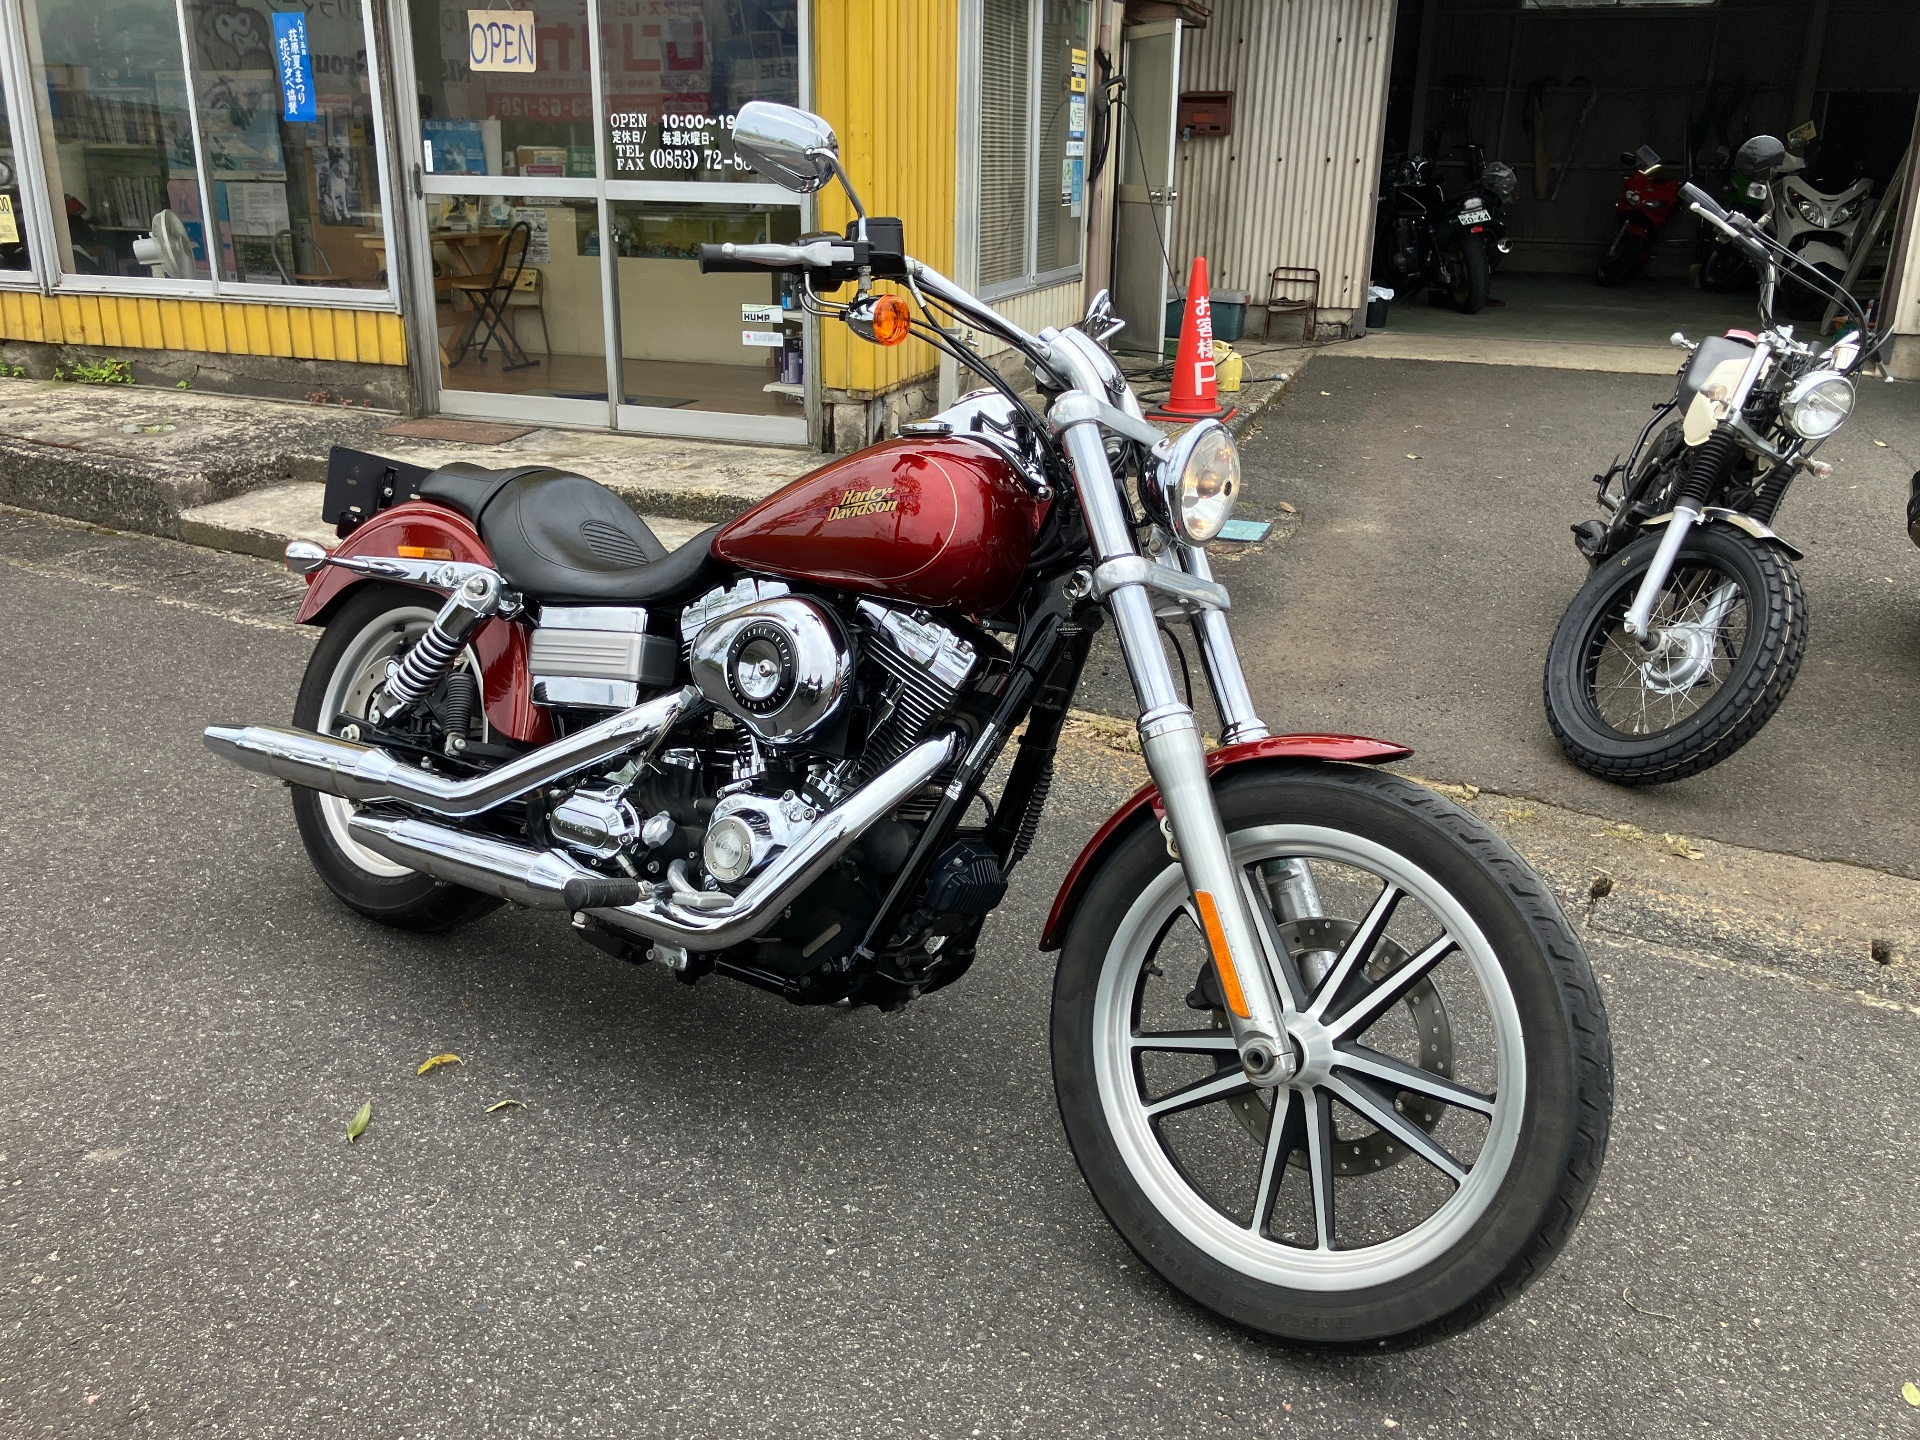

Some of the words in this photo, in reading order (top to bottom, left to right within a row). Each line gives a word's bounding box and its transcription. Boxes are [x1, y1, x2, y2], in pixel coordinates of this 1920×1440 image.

[470, 22, 534, 65] OPEN
[288, 28, 305, 105] 荘原夏まつり
[610, 113, 647, 128] OPEN
[661, 114, 735, 130] 10:00~19
[616, 145, 645, 158] TEL
[649, 149, 699, 170] (0853)
[617, 159, 645, 171] FAX
[743, 313, 770, 321] HUMP
[826, 500, 899, 522] Davidson
